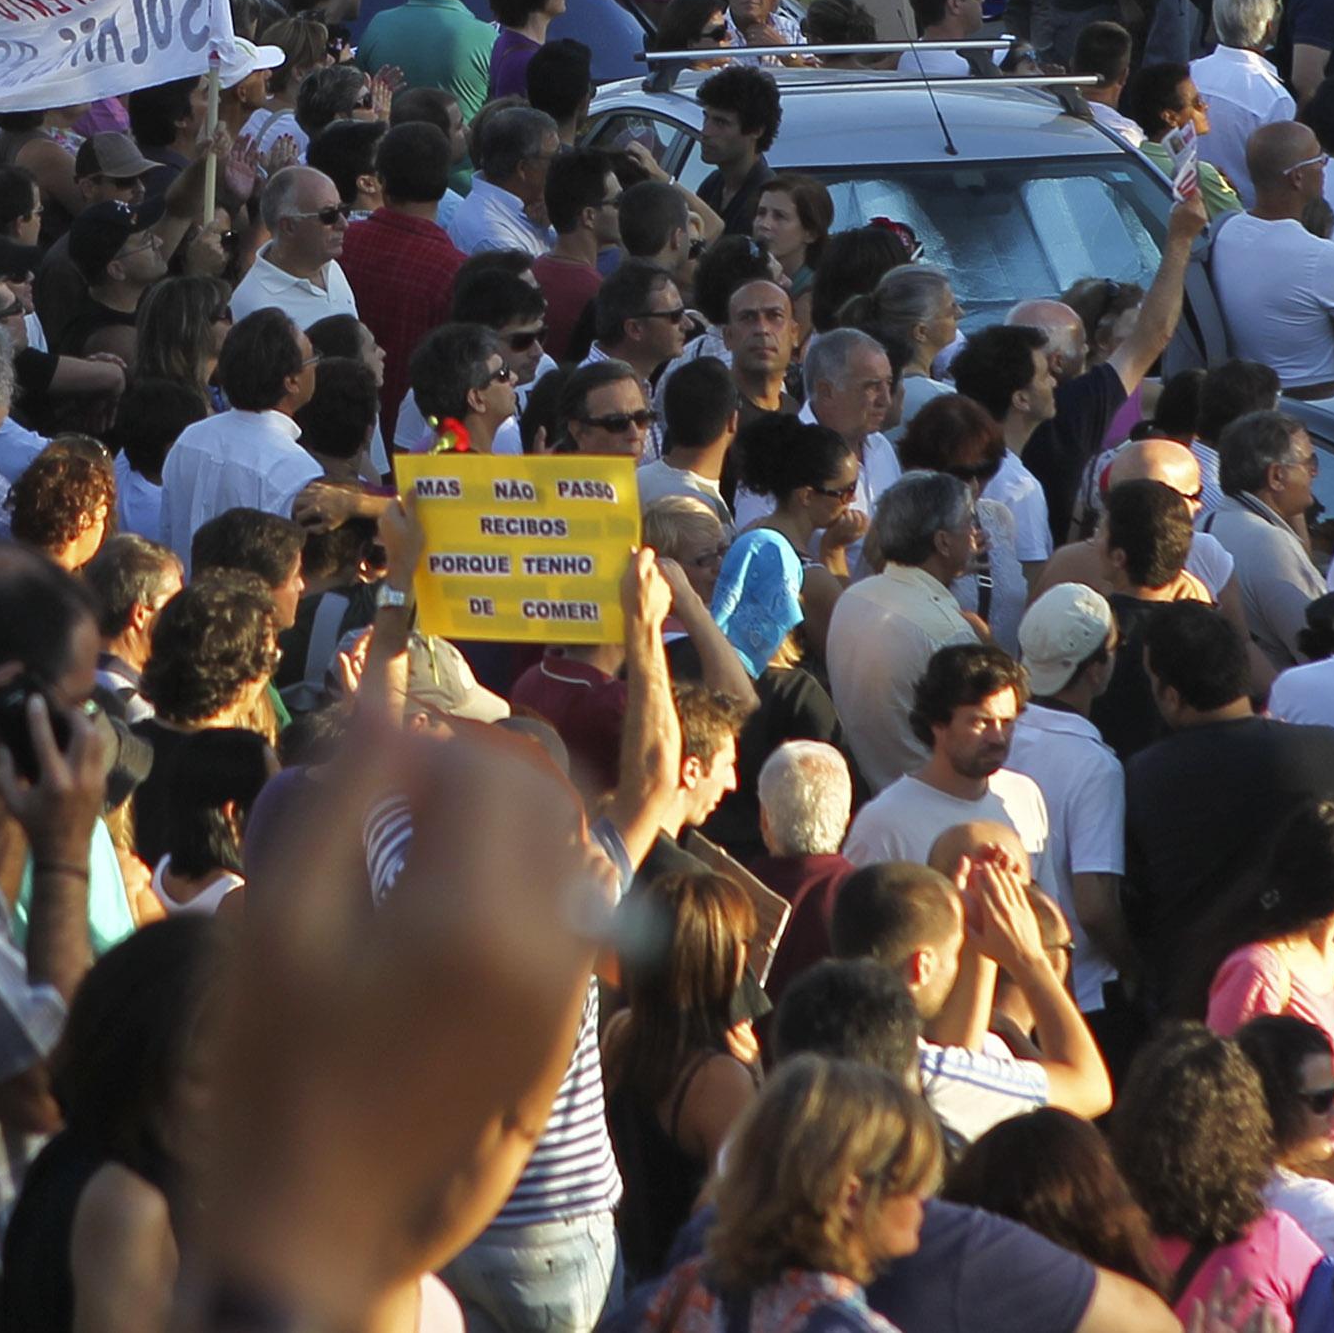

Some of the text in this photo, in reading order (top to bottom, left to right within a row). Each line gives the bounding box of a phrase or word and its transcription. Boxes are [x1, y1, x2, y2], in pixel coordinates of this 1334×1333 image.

[417, 479, 614, 500] MAS NÃO PASSO
[480, 517, 566, 536] RECIBOS
[429, 555, 591, 574] PORQUE TENHO
[470, 598, 598, 620] DE COMER!
